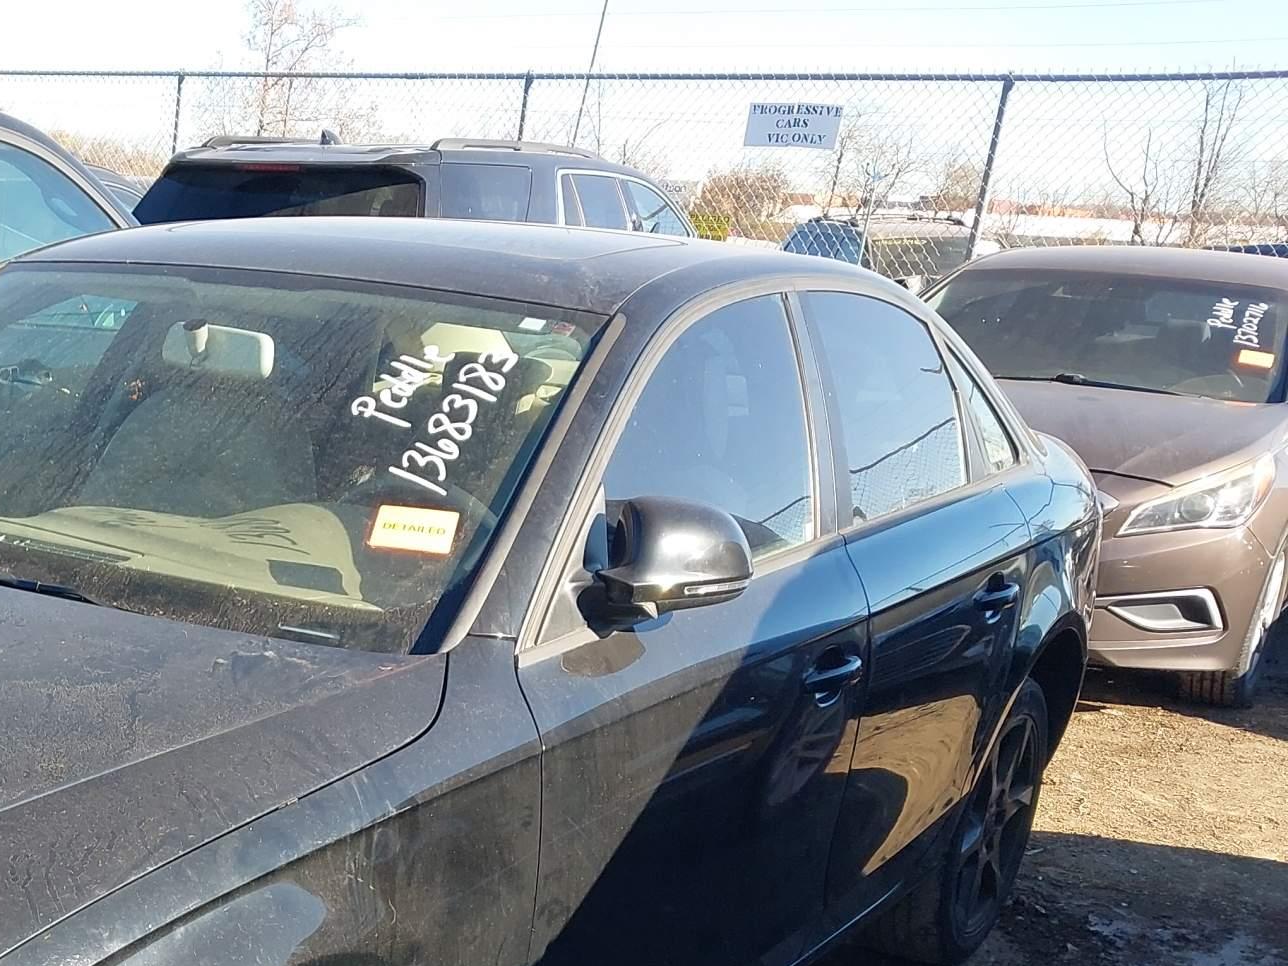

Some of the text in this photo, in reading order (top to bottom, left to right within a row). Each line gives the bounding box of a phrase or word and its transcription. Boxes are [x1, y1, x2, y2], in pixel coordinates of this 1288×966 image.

[752, 104, 843, 117] PROGRESSIVE
[776, 118, 810, 129] CARS
[767, 133, 827, 145] VIC ONLY
[388, 351, 520, 497] 13683183
[382, 521, 447, 536] DETAILED
